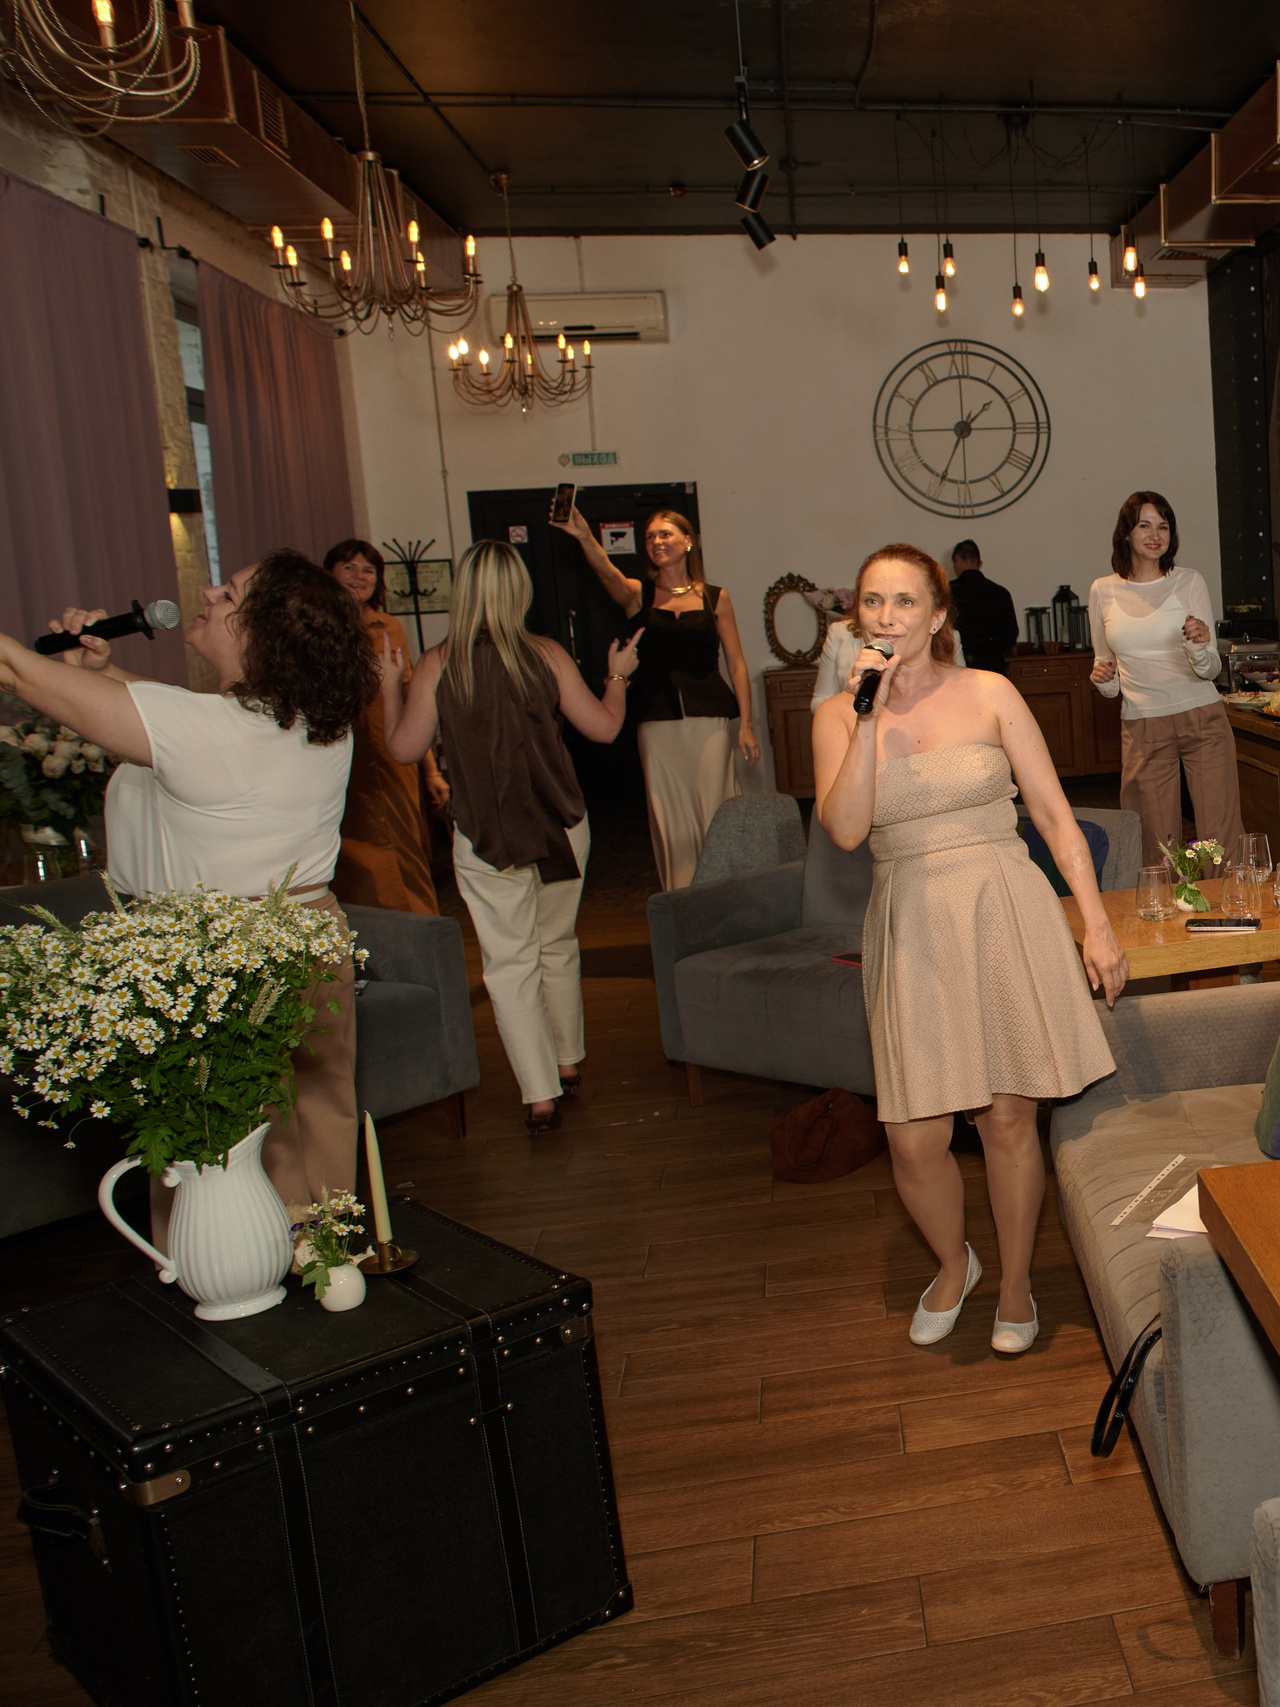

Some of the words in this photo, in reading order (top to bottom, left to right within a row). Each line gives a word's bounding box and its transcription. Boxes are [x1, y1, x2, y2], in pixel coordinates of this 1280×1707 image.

[947, 341, 969, 378] XII
[1012, 421, 1050, 435] III
[574, 453, 615, 466] ВЫХОД
